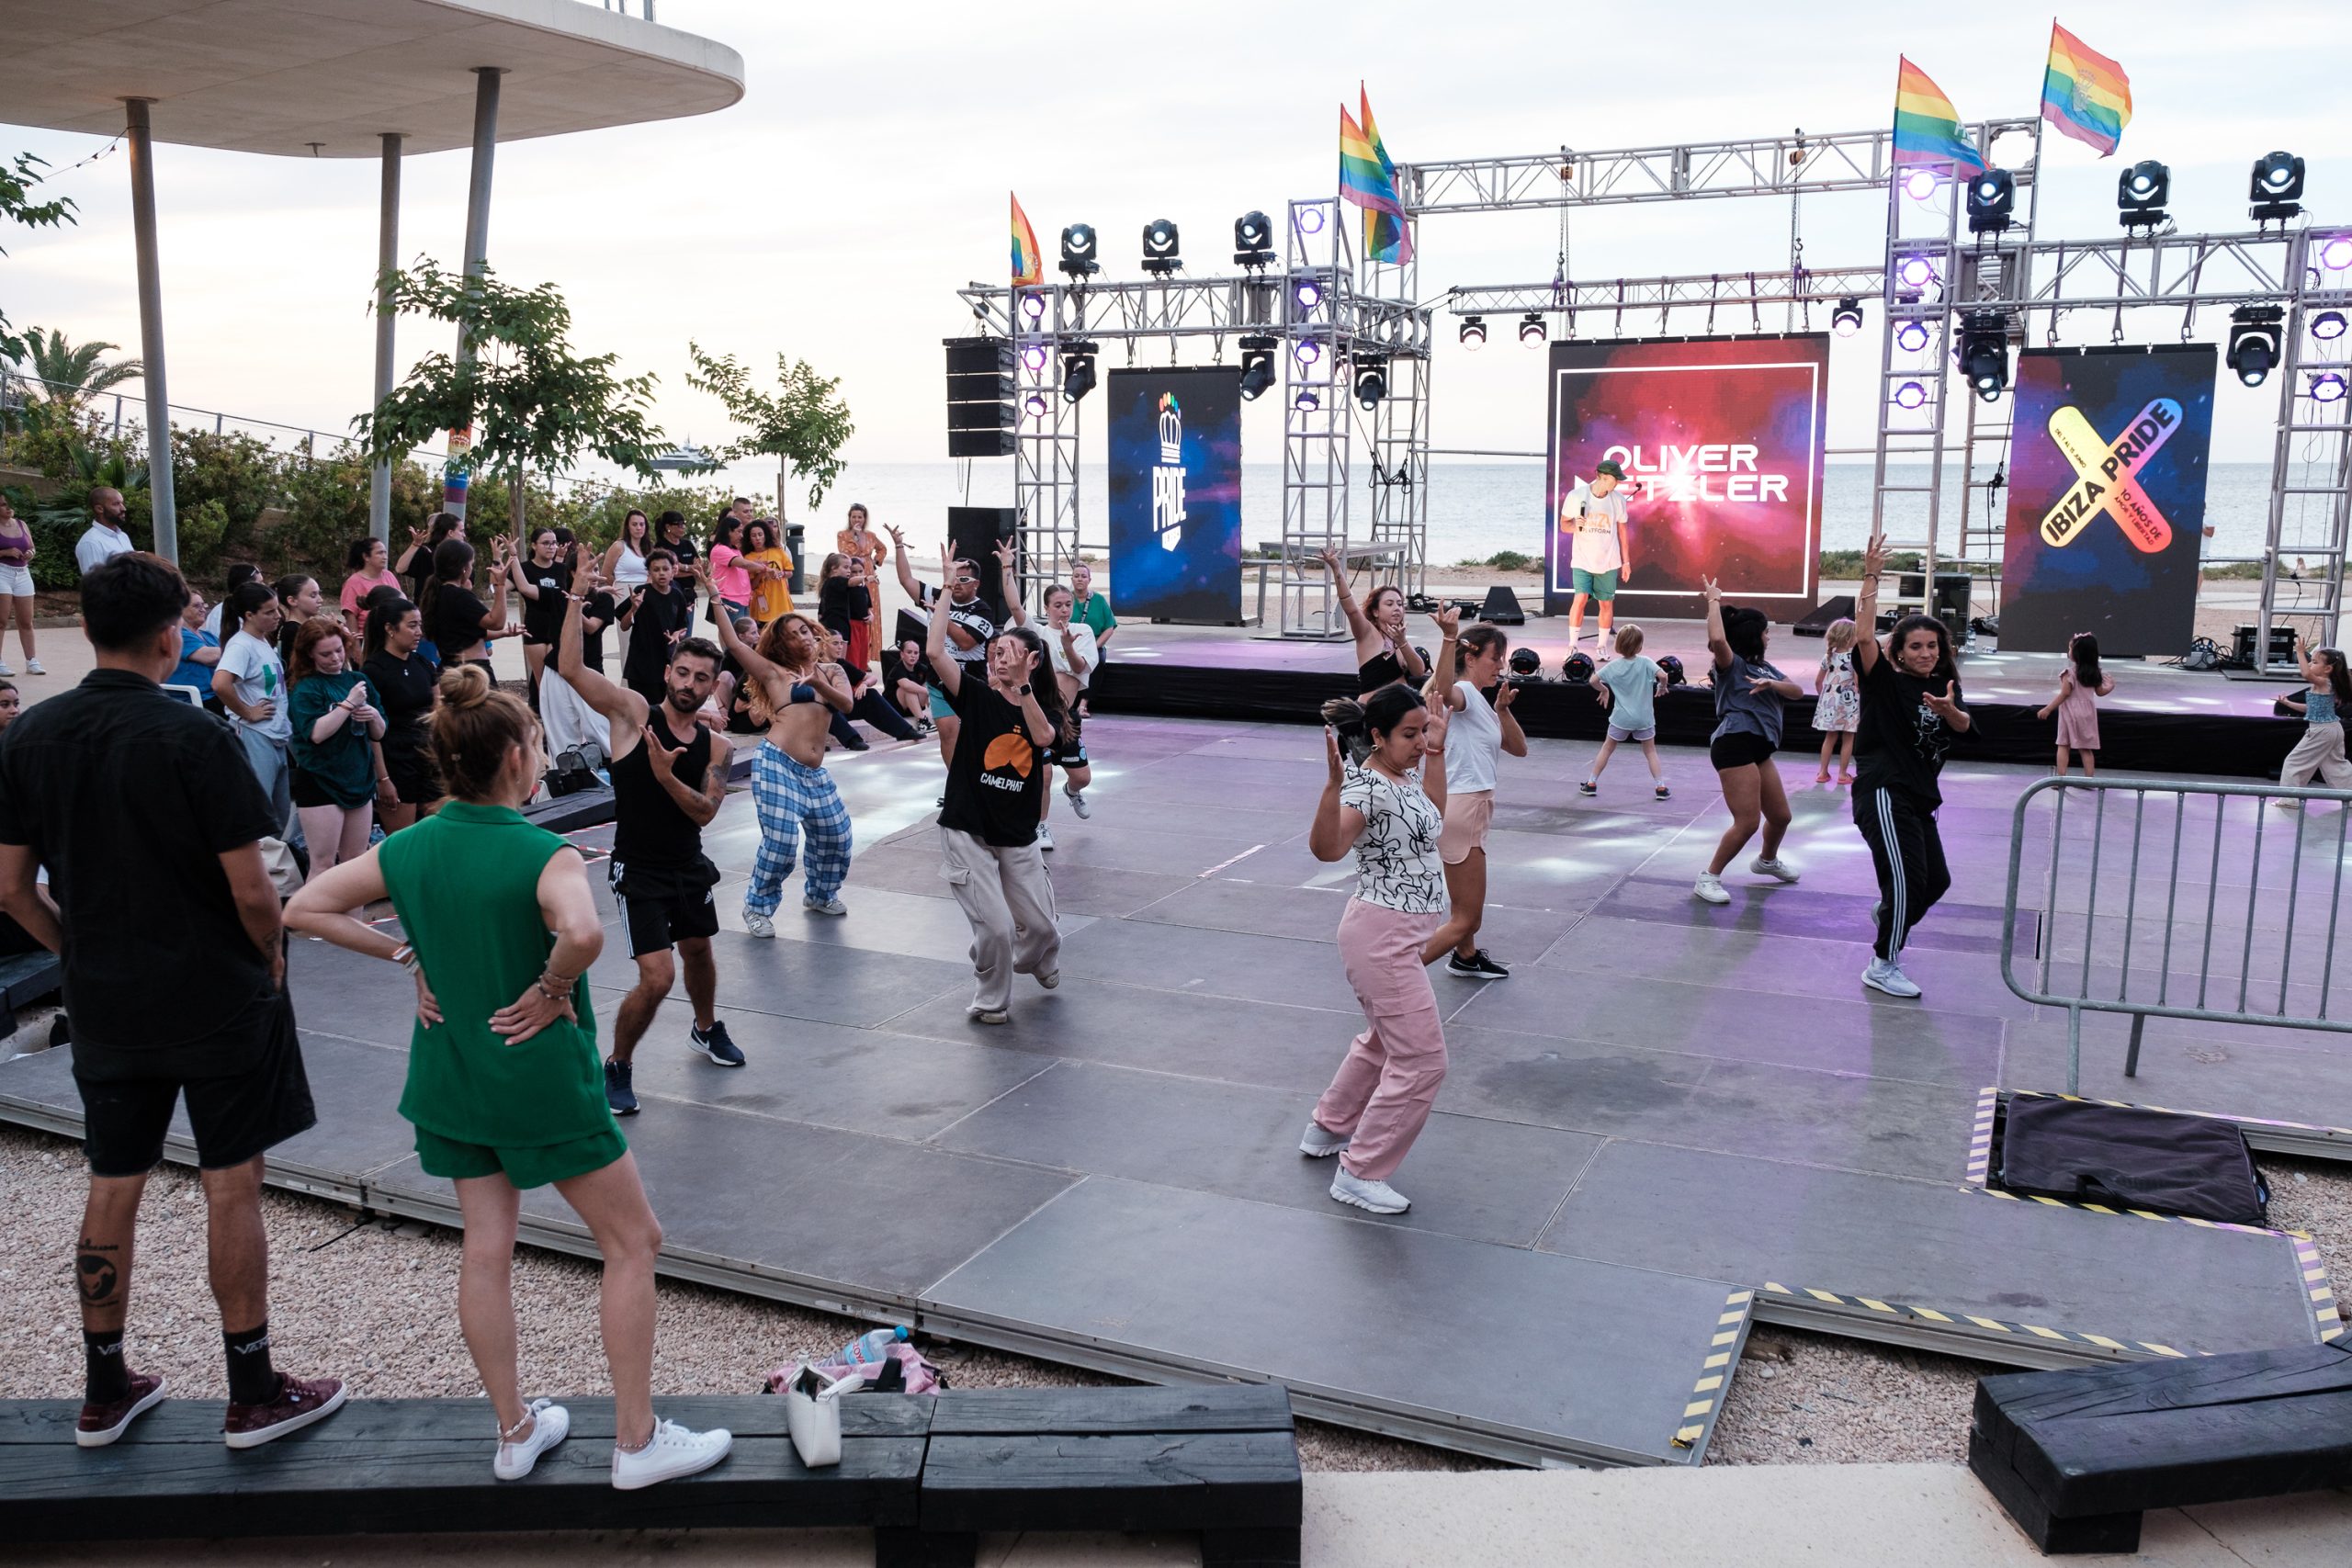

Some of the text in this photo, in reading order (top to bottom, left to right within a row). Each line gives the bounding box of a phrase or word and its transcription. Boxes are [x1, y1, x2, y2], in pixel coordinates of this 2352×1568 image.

[1602, 444, 1758, 472] OLIVER
[2046, 402, 2175, 542] IBIZA PRIDE
[1152, 466, 1187, 532] PRIDE
[2114, 496, 2129, 513] AMOR
[2132, 517, 2154, 546] LIBERTAD
[2120, 488, 2163, 541] 10 AÑOS DE
[978, 620, 990, 634] 23
[979, 773, 1024, 793] CAMELPHAT
